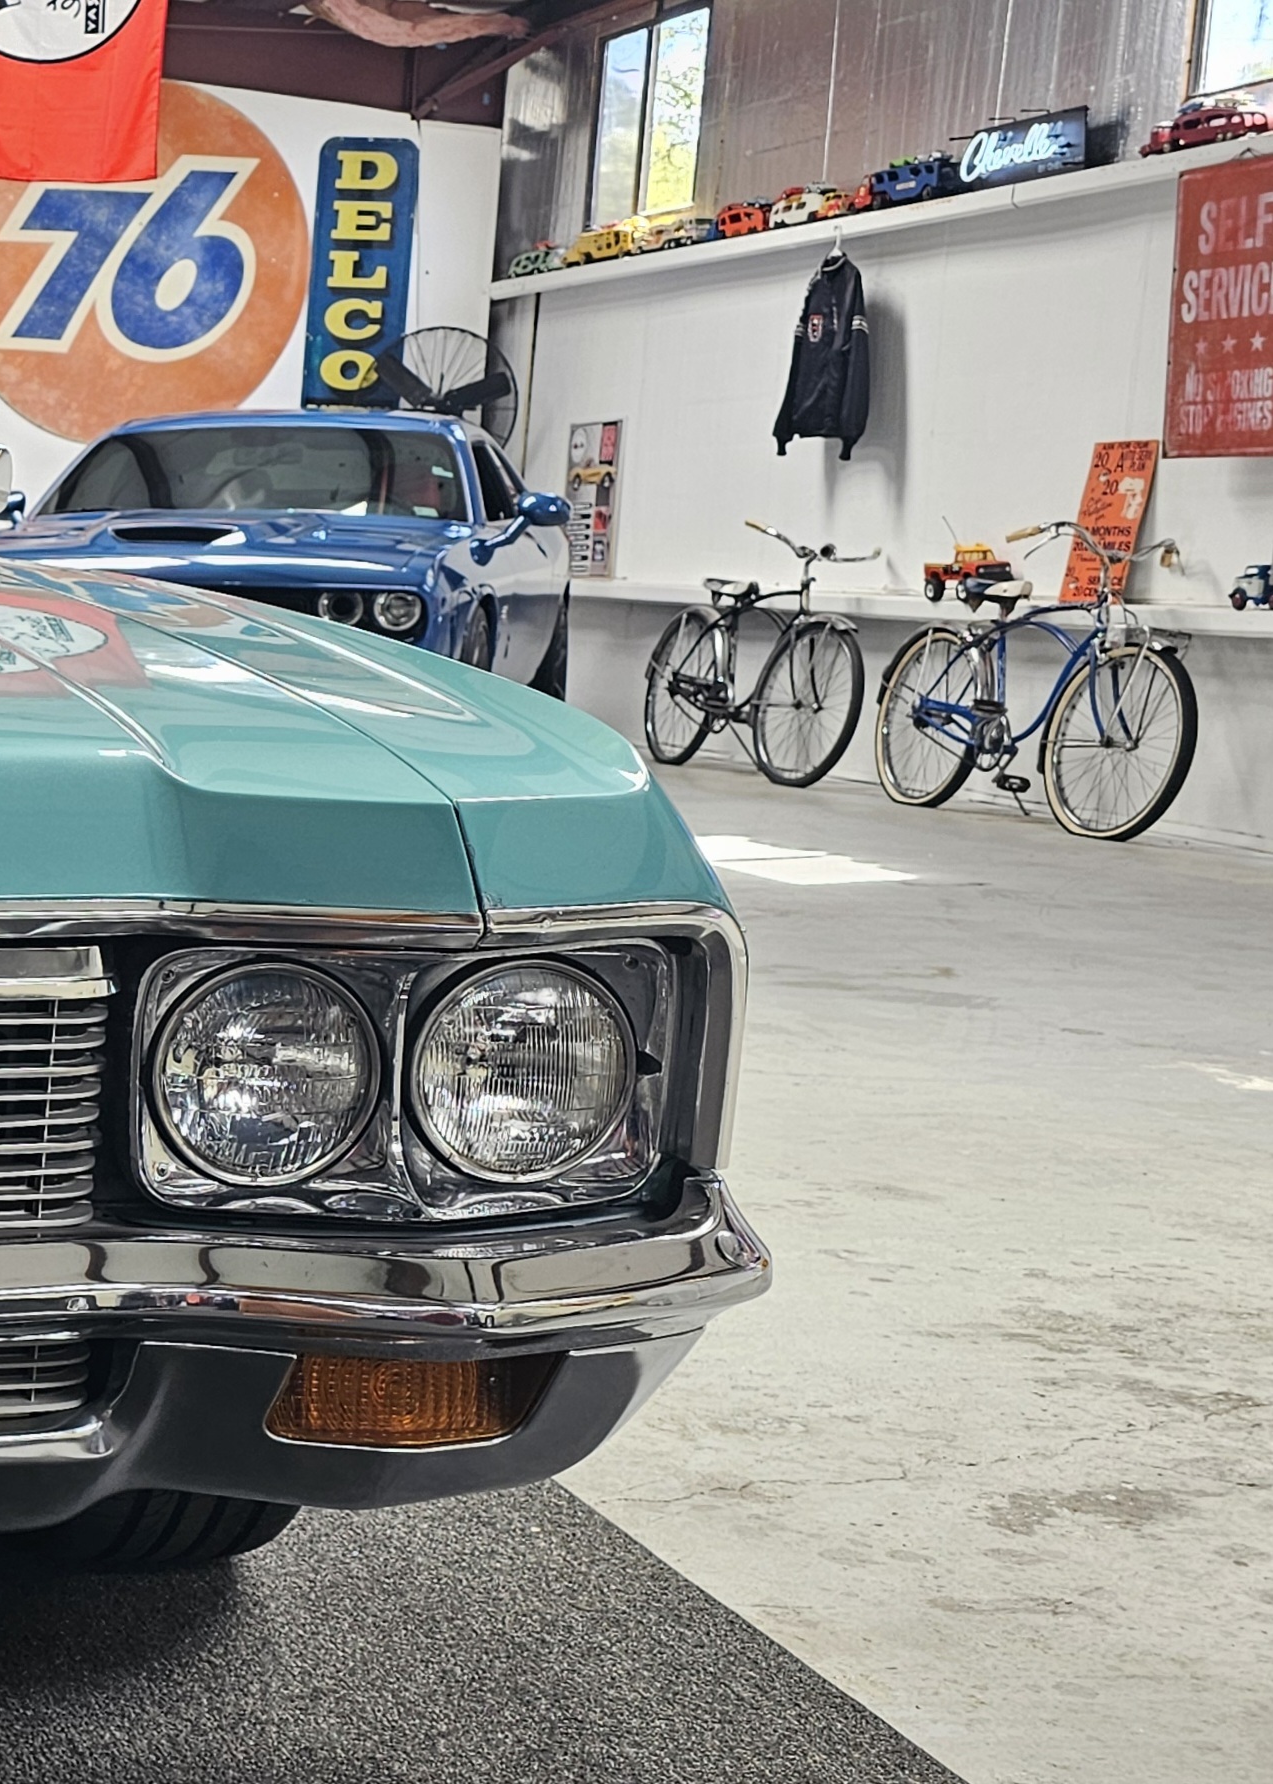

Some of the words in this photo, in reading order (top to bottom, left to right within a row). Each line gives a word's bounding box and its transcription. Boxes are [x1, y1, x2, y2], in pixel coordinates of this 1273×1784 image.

[960, 122, 1059, 182] Chevelle
[1198, 191, 1273, 255] SELF
[319, 151, 399, 391] DELCO
[1181, 261, 1273, 323] SERVIC
[1185, 370, 1203, 402] NO
[1180, 403, 1213, 434] STOP
[1102, 480, 1119, 495] 20
[1091, 526, 1131, 537] MONTHS
[1103, 541, 1131, 552] MILES
